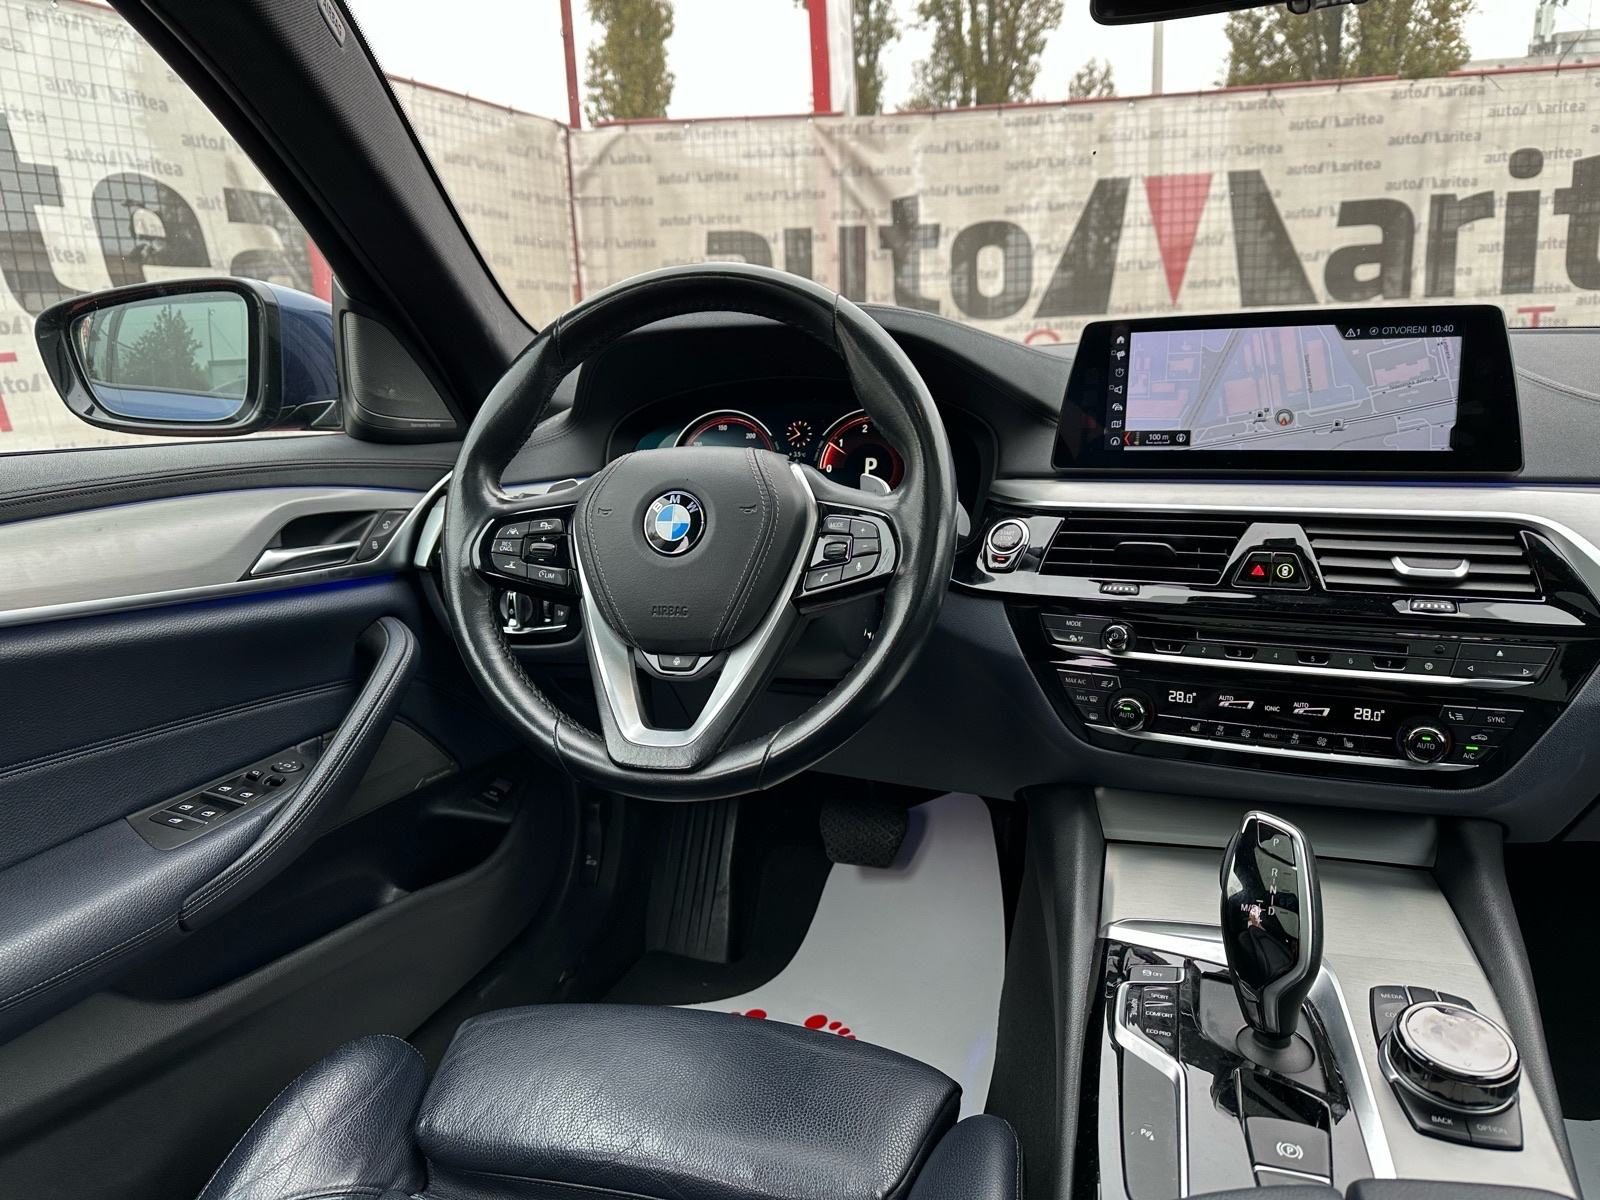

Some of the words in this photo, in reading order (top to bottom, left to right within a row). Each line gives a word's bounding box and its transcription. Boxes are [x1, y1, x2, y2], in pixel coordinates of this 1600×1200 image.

[1381, 325, 1428, 335] OTVORENI
[1431, 324, 1454, 334] 10:40
[718, 424, 728, 432] 150
[861, 424, 868, 433] 2
[745, 432, 757, 440] 200
[1148, 433, 1161, 441] 100
[838, 438, 844, 448] 1
[826, 464, 832, 473] 0
[864, 457, 878, 474] P
[652, 494, 700, 514] BMW
[650, 604, 690, 618] AIRBAG
[1065, 619, 1082, 627] MODE
[1065, 677, 1077, 685] MAX
[1077, 678, 1087, 686] A/C
[1075, 694, 1089, 702] MAX
[1167, 690, 1197, 704] 28.0°
[1218, 694, 1234, 702] AUTO
[1264, 704, 1281, 713] IONIC
[1293, 701, 1310, 709] AUTO
[1118, 710, 1135, 719] AUTO
[1353, 707, 1386, 722] 28.0°
[1486, 716, 1506, 724] SYNC
[1416, 741, 1436, 751] AUTO
[1462, 751, 1475, 760] A/C
[1272, 838, 1280, 847] P
[1271, 867, 1279, 877] R
[1269, 884, 1277, 895] N
[1267, 906, 1275, 916] D
[1150, 992, 1169, 1000] SPORT
[1380, 992, 1404, 1000] MEDIA
[1145, 1010, 1173, 1019] COMFORT
[1158, 1029, 1172, 1037] PRO
[1431, 1115, 1453, 1126] BACK
